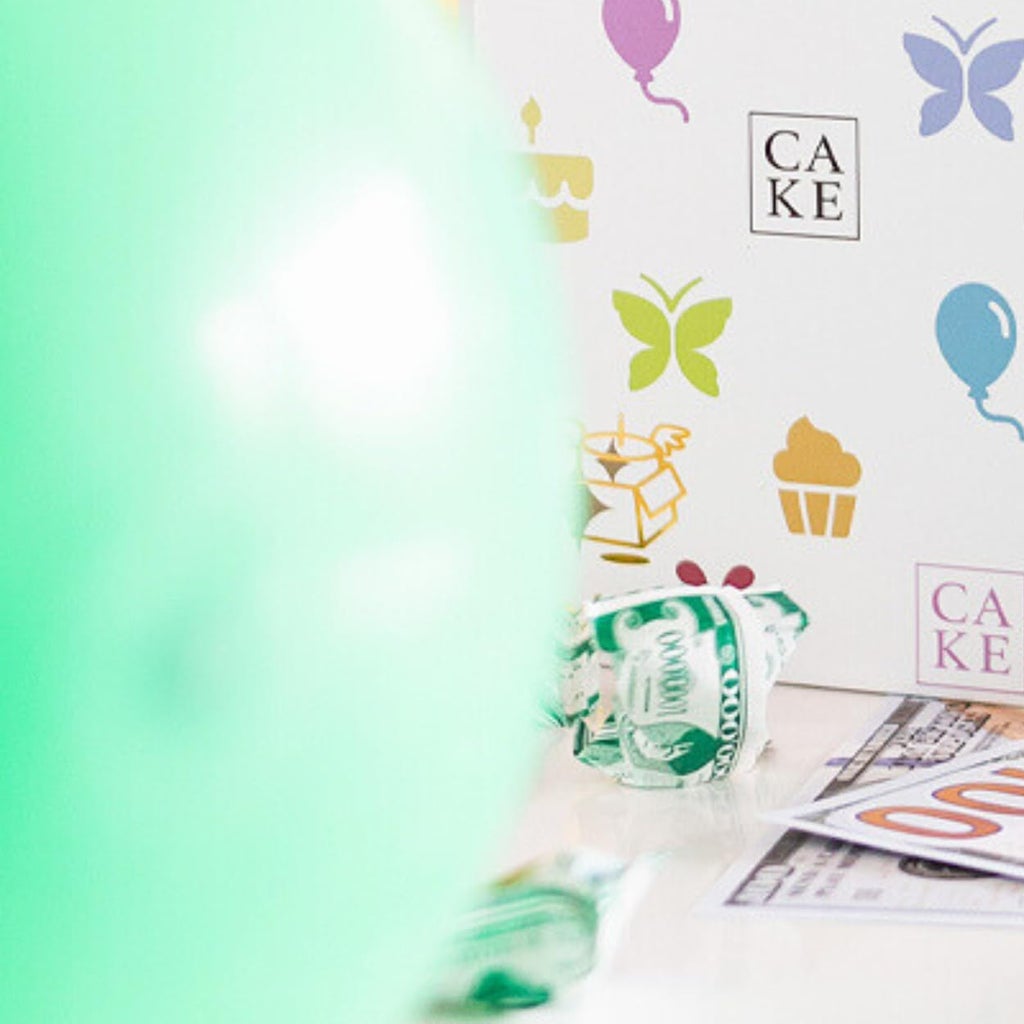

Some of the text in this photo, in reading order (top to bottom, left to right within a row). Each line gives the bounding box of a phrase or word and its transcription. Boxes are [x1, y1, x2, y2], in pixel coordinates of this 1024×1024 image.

[764, 129, 844, 175] CA
[767, 177, 844, 221] KE
[931, 581, 1012, 628] CA
[933, 629, 1011, 675] KE
